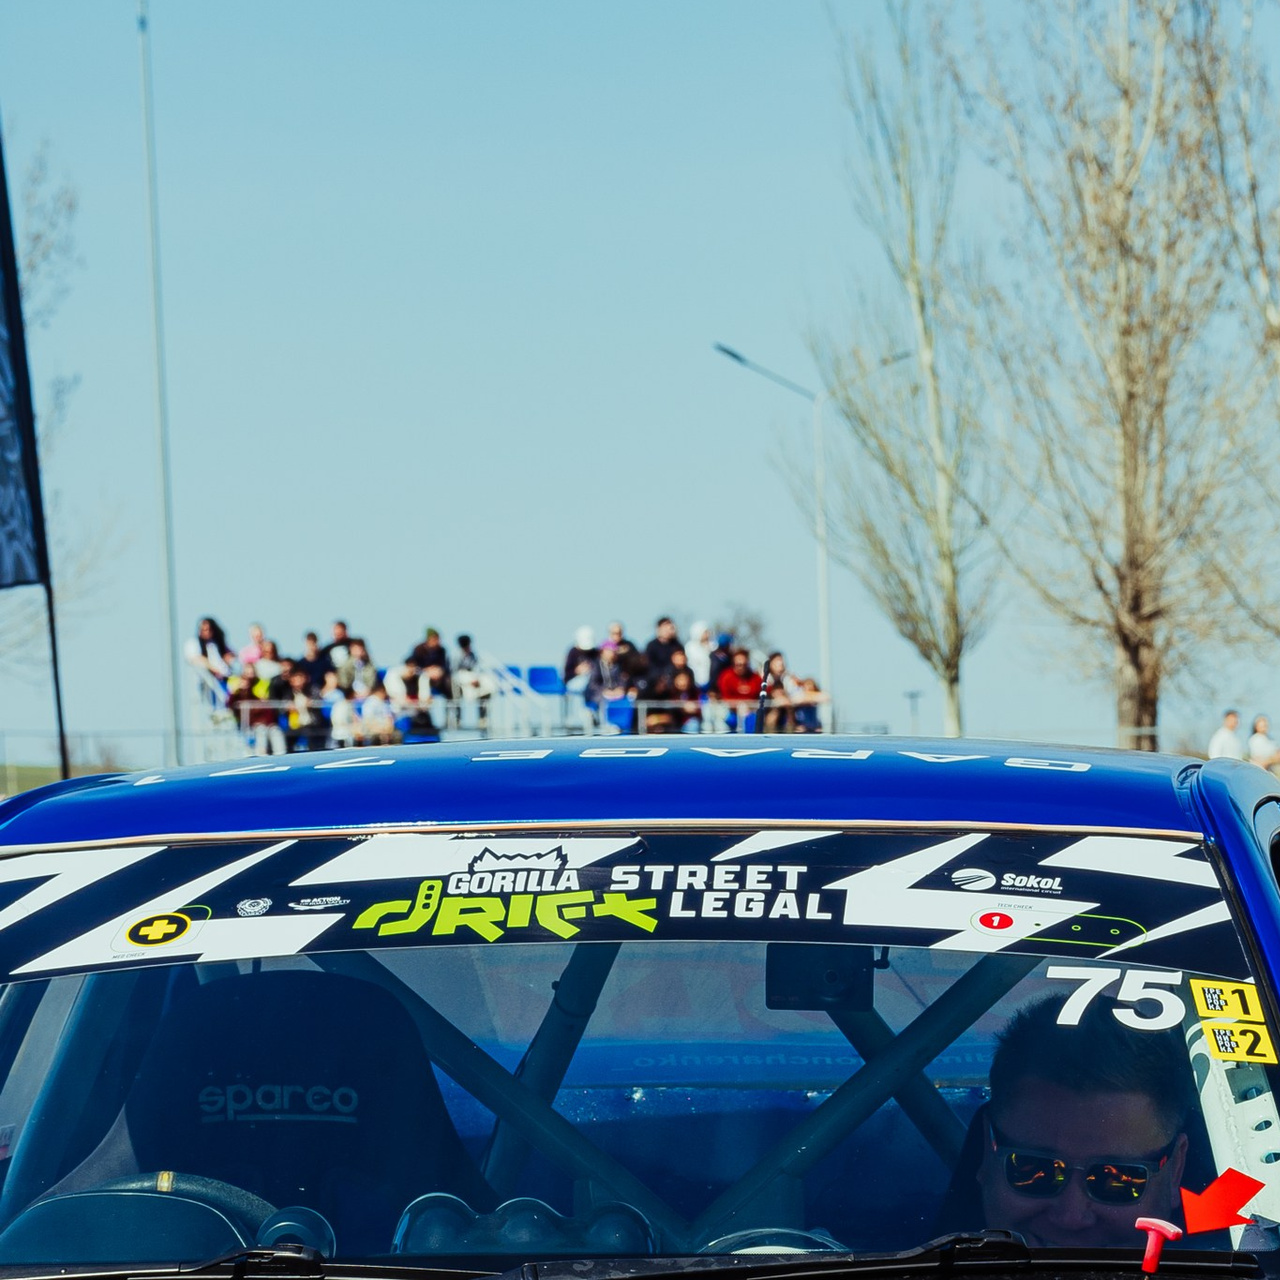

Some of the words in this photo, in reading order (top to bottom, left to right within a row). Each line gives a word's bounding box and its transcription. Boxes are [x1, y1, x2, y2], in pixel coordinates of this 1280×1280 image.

[470, 747, 1093, 773] GARAGE
[447, 869, 582, 895] GORILLA
[610, 864, 808, 891] STREET
[668, 892, 833, 920] LEGAL
[991, 915, 1001, 927] 1
[1046, 966, 1187, 1031] 75
[1231, 988, 1251, 1016] 1
[1239, 1029, 1268, 1057] 2
[198, 1083, 359, 1122] sparco
